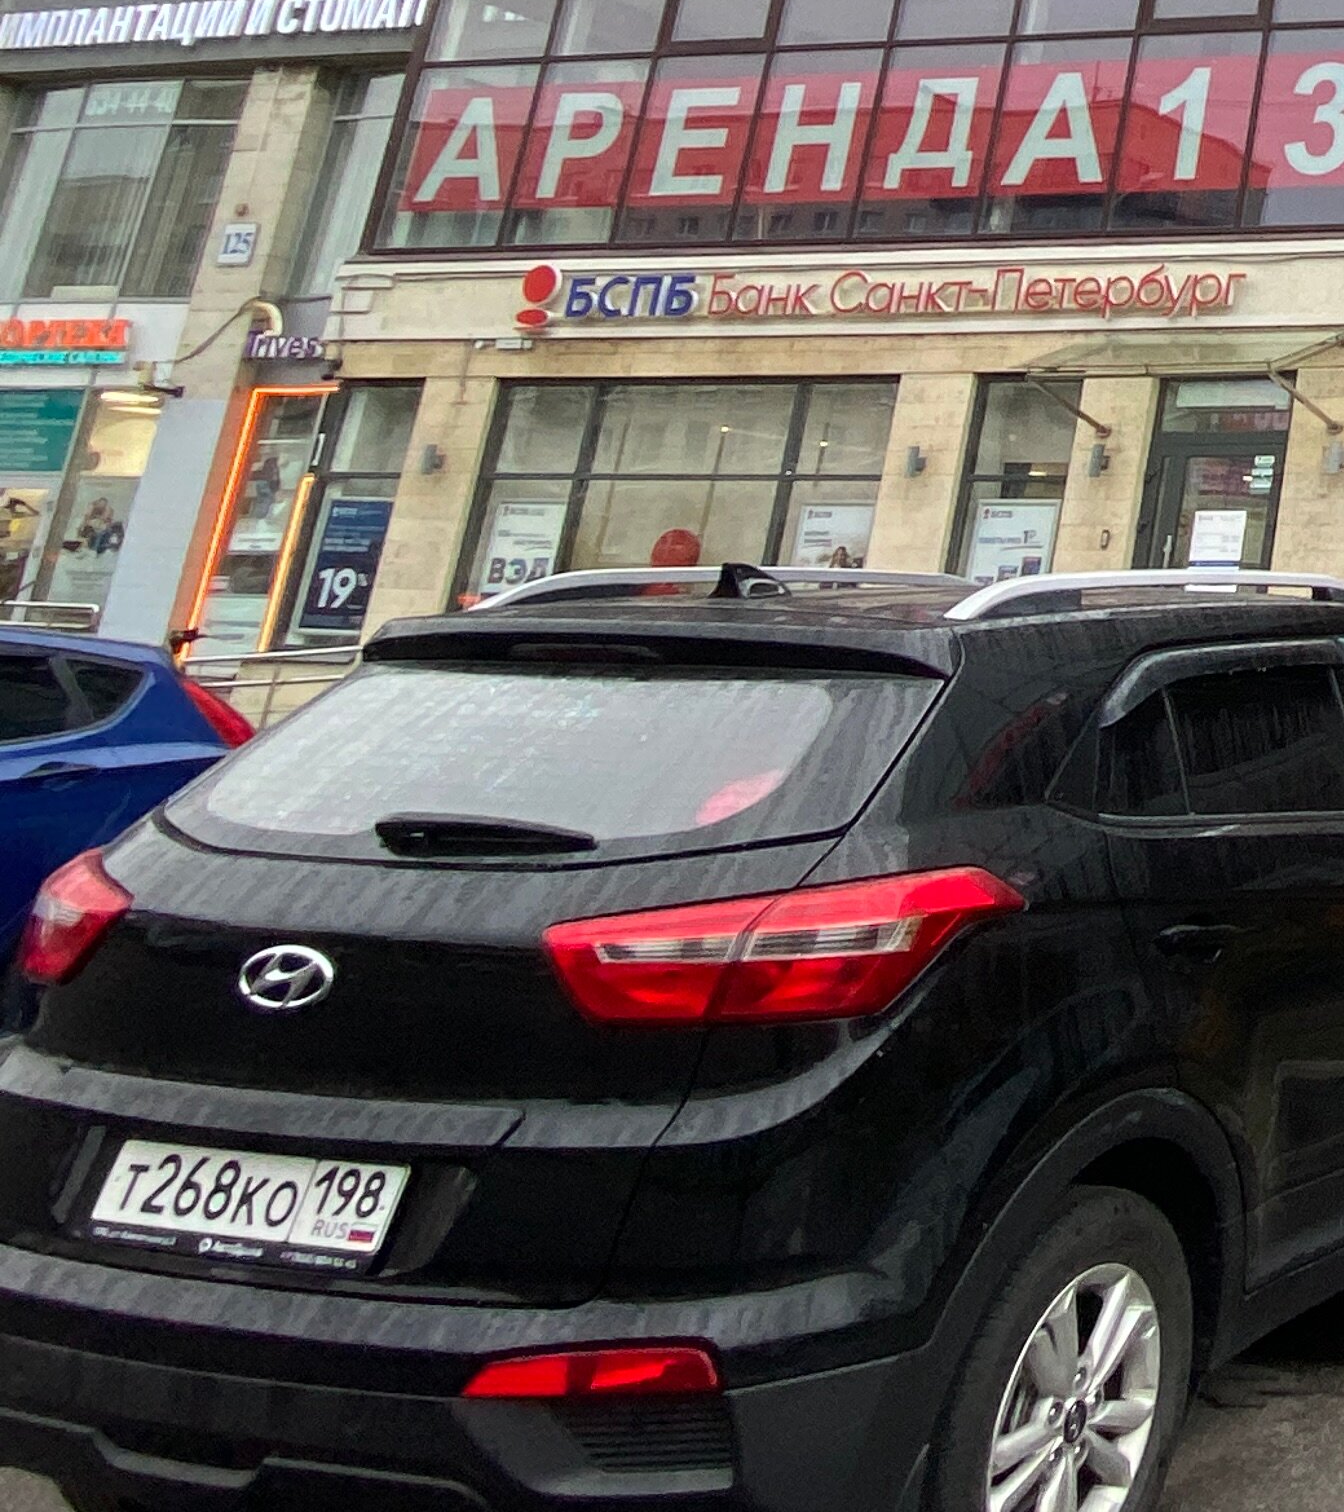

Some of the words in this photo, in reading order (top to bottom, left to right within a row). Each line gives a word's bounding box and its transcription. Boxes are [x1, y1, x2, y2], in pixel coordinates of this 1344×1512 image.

[412, 71, 1103, 203] АРЕНДА
[222, 231, 252, 256] 125
[564, 274, 697, 319] БСПБ
[708, 273, 820, 316] Банк
[829, 264, 1248, 319] Санкт-Петербург
[119, 1153, 299, 1227] Т268КО
[314, 1165, 387, 1219] 198
[310, 1219, 348, 1240] RUS
